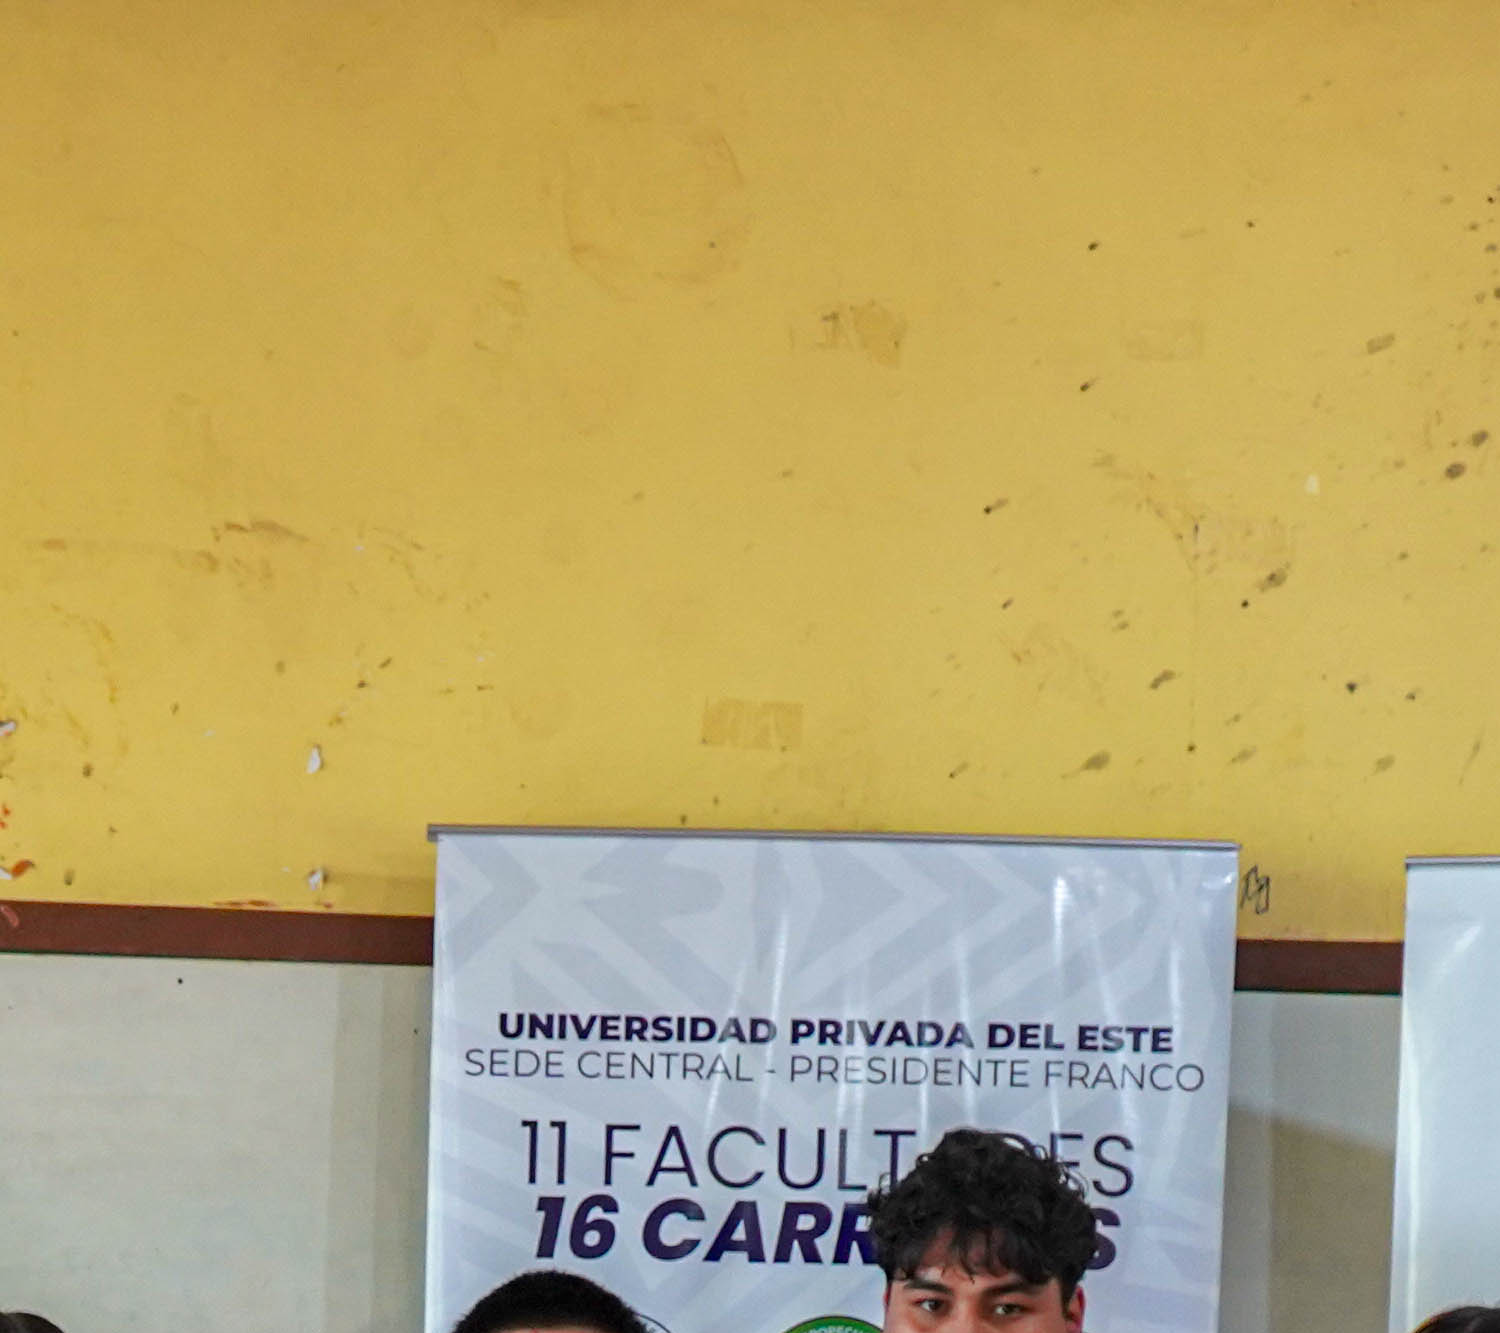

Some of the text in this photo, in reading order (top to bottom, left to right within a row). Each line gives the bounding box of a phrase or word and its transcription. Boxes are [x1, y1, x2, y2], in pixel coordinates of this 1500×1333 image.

[499, 1012, 1174, 1053] UNIVERSIDAD PRIVADA DEL ESTE
[464, 1048, 566, 1079] SEDE
[578, 1051, 754, 1083] CENTRAL
[790, 1055, 1030, 1089] PRESIDENTE
[1044, 1060, 1206, 1093] FRANCO
[520, 1119, 1135, 1198] 11 FACULTES
[535, 1193, 1121, 1271] 16 CARRS
